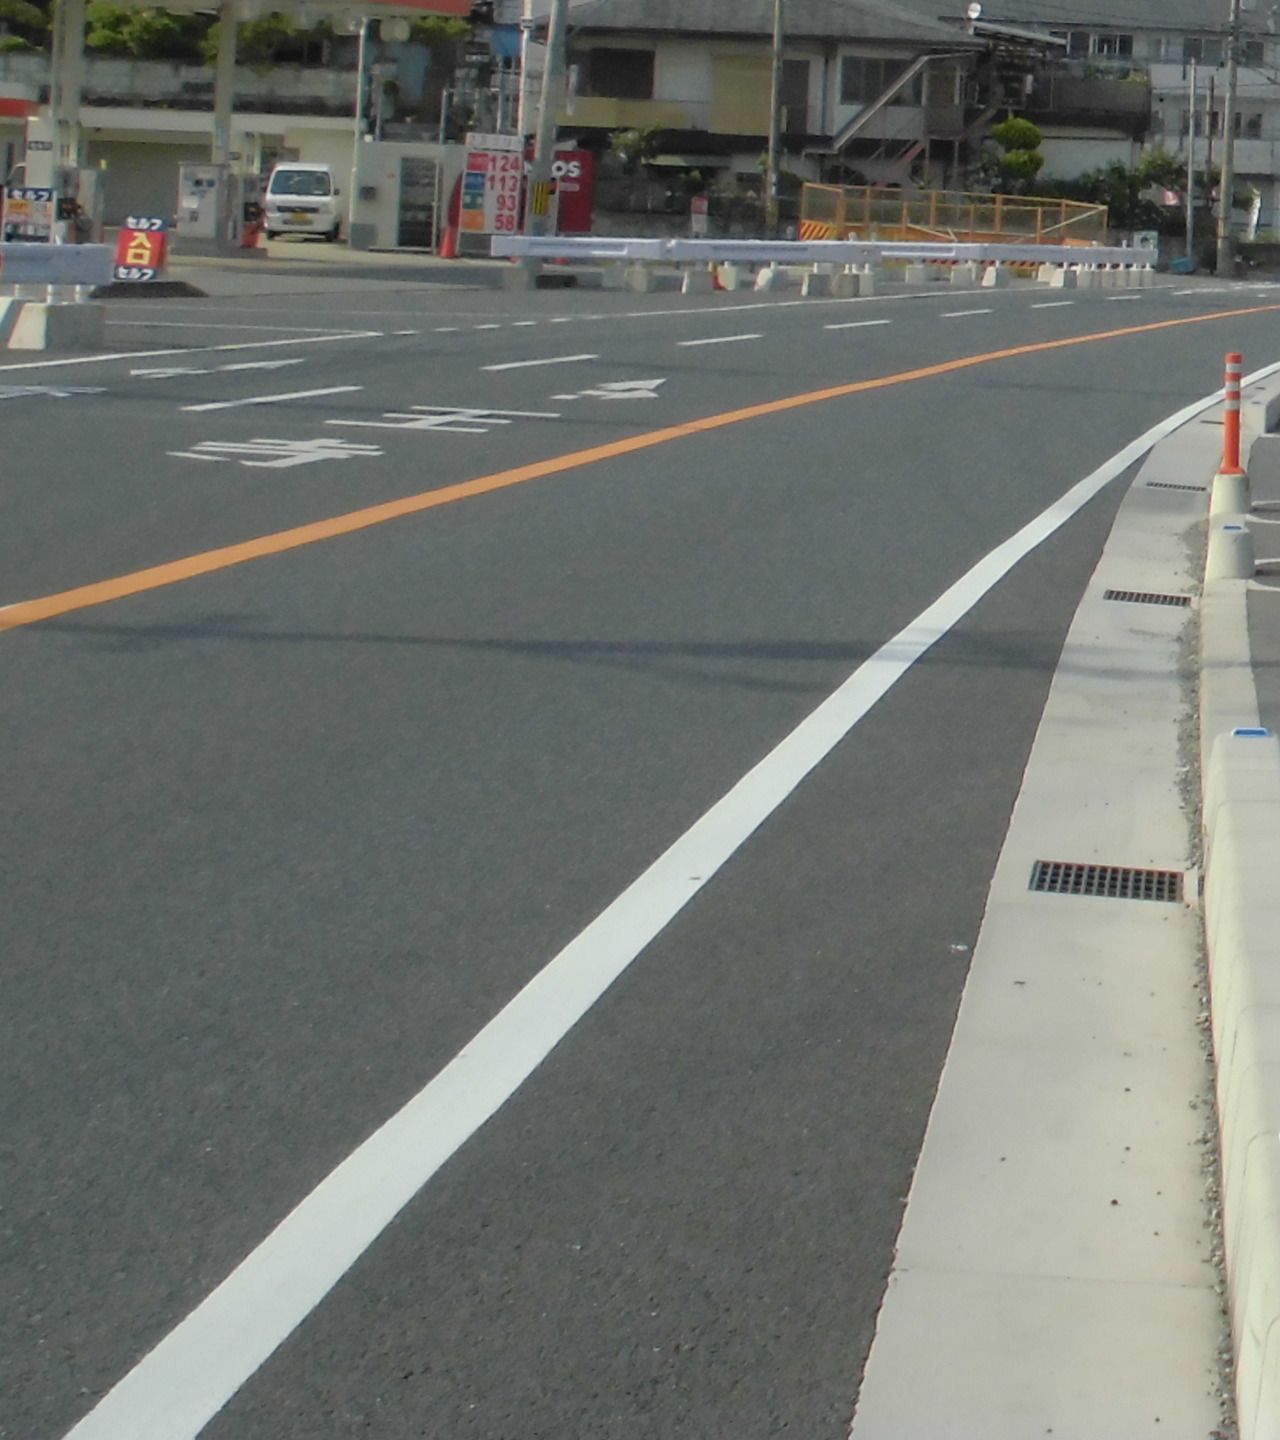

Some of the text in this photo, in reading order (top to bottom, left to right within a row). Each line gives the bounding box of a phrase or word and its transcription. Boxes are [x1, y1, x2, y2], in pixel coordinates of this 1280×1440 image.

[489, 154, 520, 172] 124
[488, 173, 518, 192] 113
[496, 194, 516, 212] 93
[127, 216, 162, 230] セルフ
[494, 214, 515, 231] 58
[127, 232, 152, 265] 入口
[118, 267, 154, 279] セルフ
